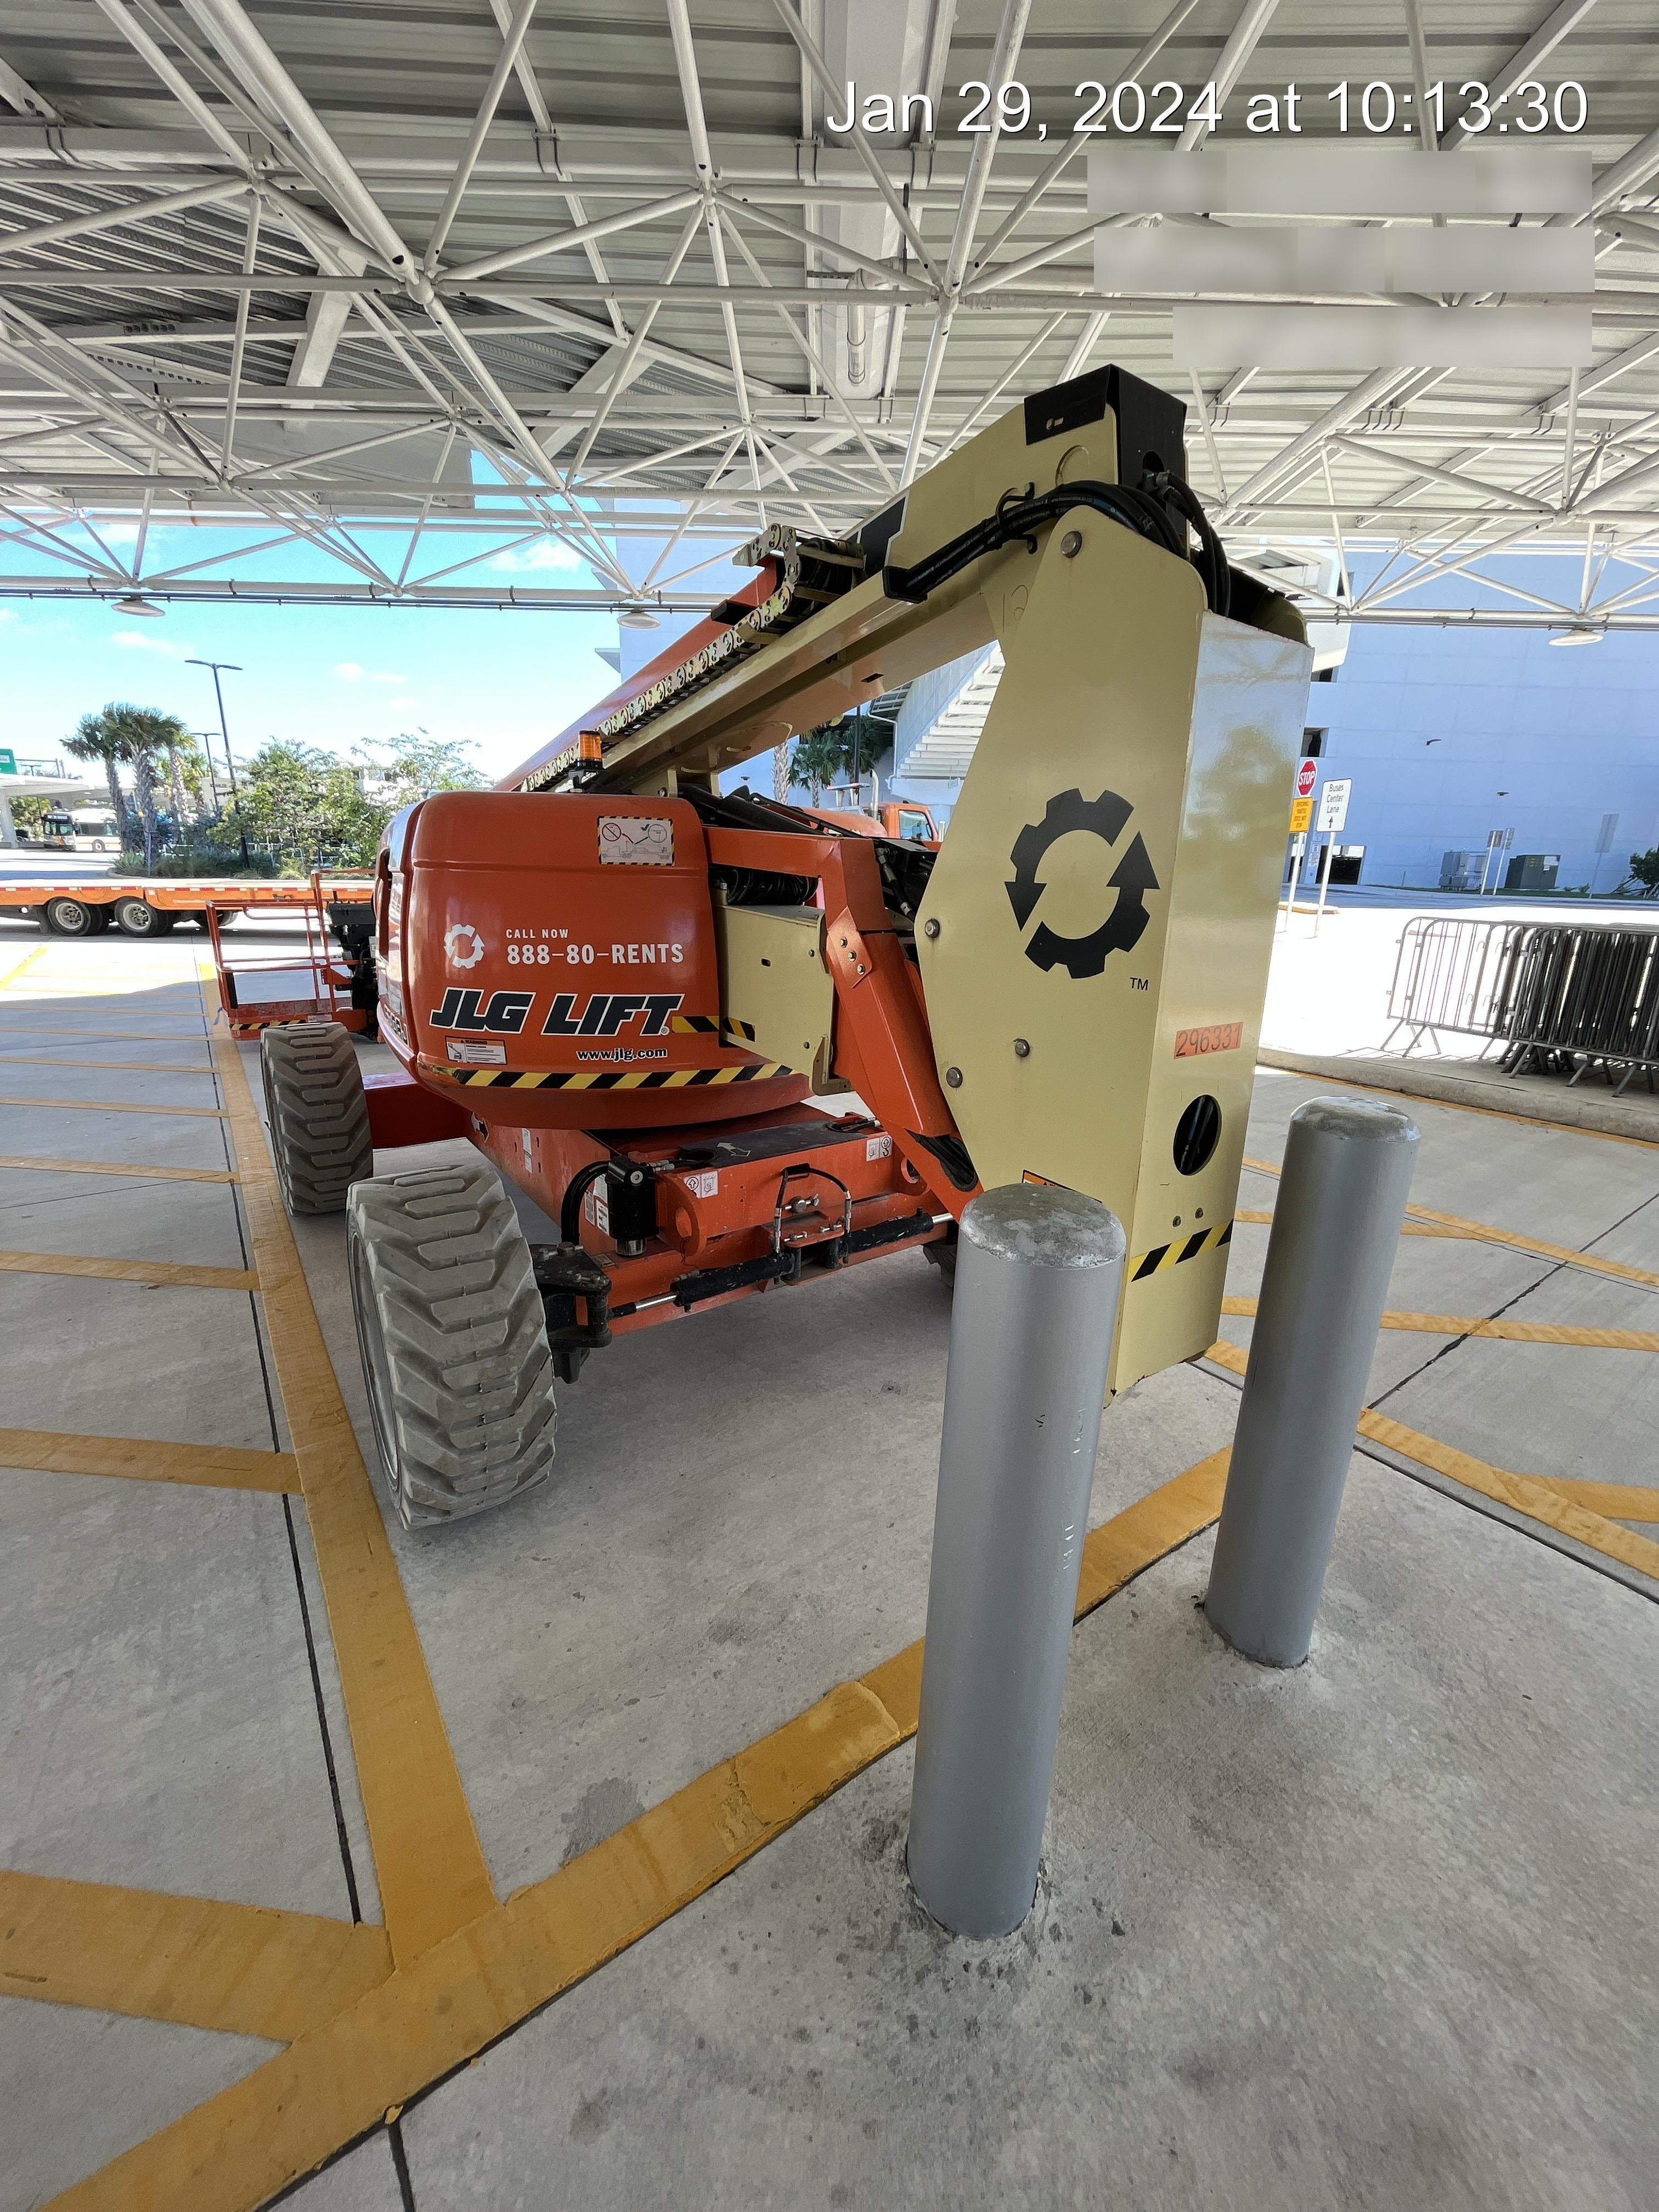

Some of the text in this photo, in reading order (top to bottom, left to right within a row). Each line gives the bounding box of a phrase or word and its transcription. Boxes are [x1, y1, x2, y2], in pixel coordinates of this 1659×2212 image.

[1299, 771, 1315, 786] STOP
[1329, 783, 1344, 792] Buses
[1327, 794, 1344, 803] Center
[1327, 805, 1339, 813] Lane
[506, 929, 568, 939] CALL NOW
[506, 944, 684, 965] 888-80-RENTS
[1130, 977, 1149, 991] TM
[429, 986, 537, 1034] JLG
[541, 993, 685, 1036] LIFT
[1175, 1022, 1242, 1057] 296331
[576, 1047, 668, 1063] www.jlg.com
